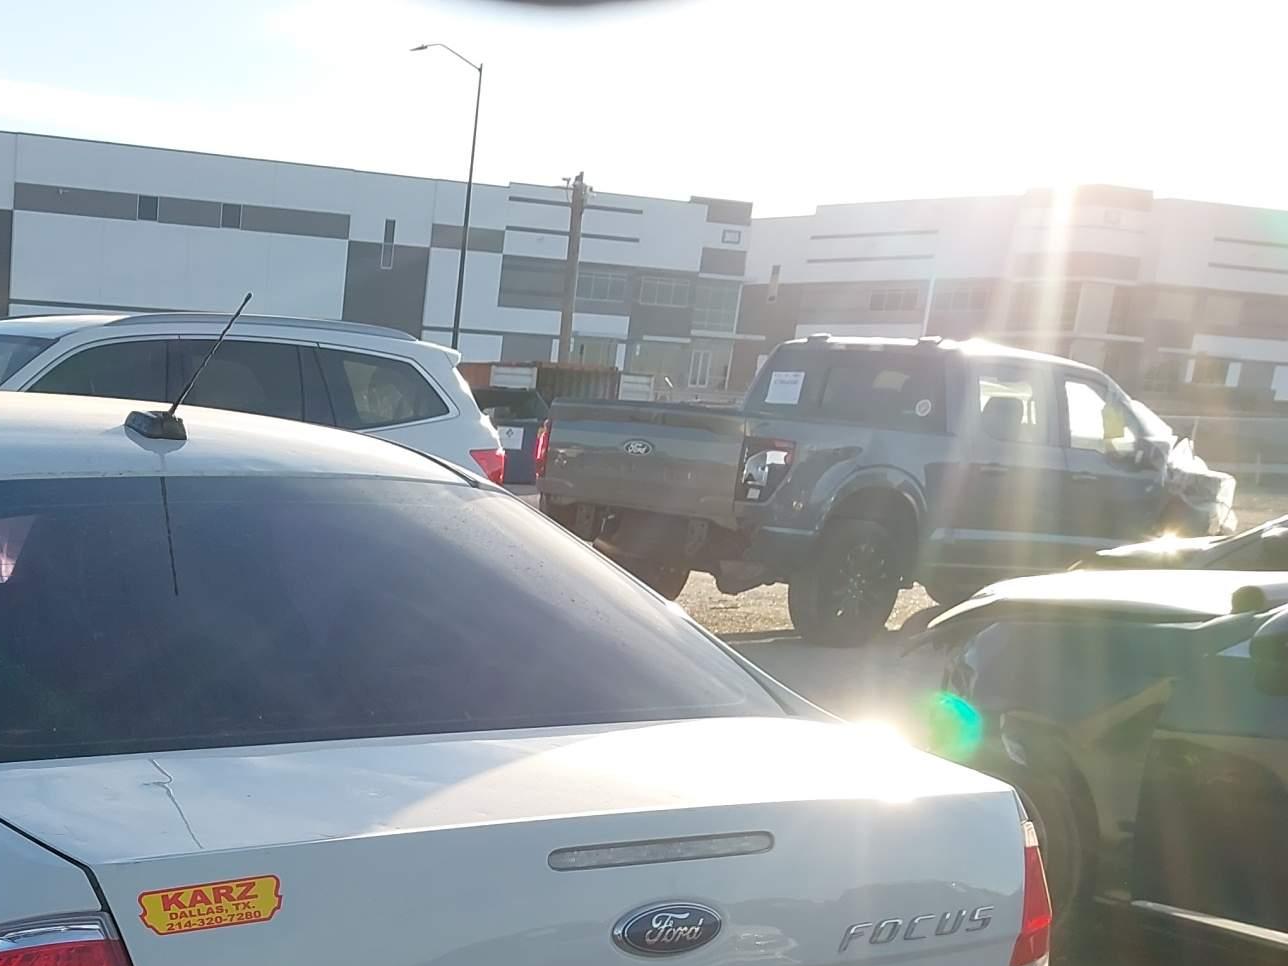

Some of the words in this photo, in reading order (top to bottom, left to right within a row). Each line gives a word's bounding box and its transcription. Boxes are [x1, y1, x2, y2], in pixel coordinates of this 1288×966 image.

[161, 881, 258, 912] KARZ
[169, 904, 229, 921] DALLAS,
[232, 901, 256, 912] TX.
[166, 910, 262, 931] 214-320-7280
[645, 912, 704, 945] Ford
[838, 905, 995, 953] FOCUS
